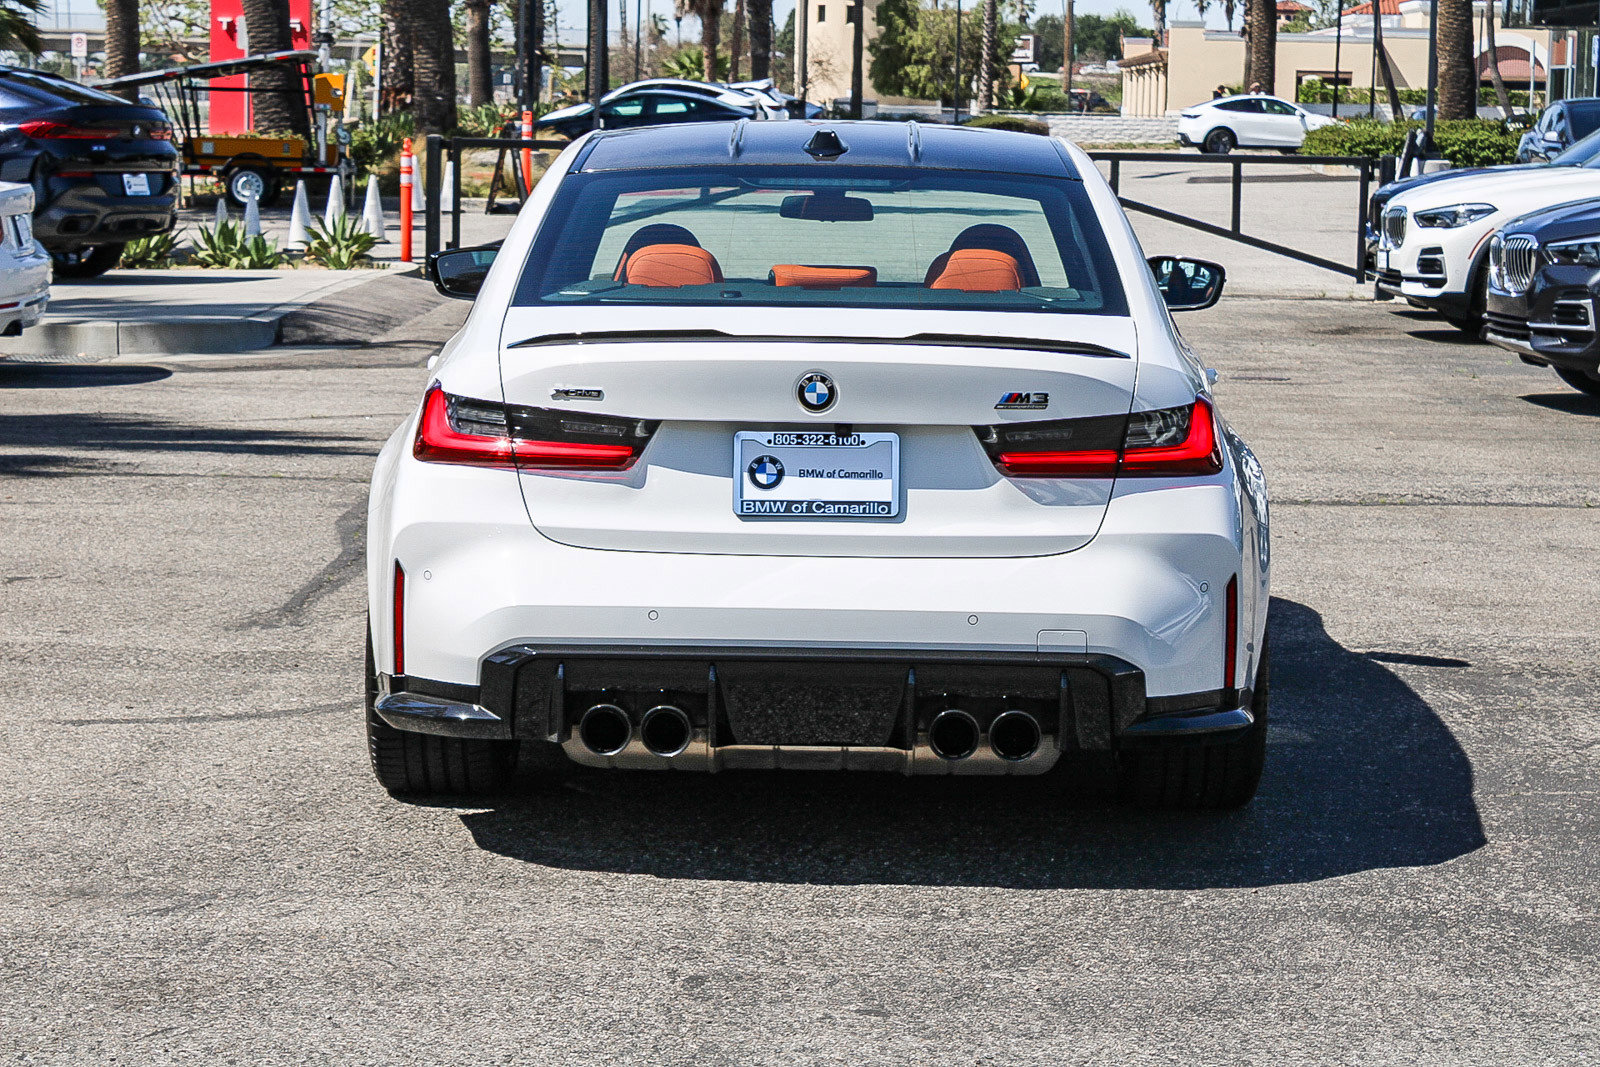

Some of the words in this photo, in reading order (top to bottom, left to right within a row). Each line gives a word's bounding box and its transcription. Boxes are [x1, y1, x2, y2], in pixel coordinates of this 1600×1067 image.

[801, 375, 833, 388] BMW
[775, 434, 859, 446] 805-322-6100
[751, 456, 783, 470] BMW
[798, 469, 825, 478] BMW
[826, 469, 837, 479] of
[837, 469, 884, 479] Camarillo
[742, 501, 787, 513] BMW
[791, 501, 808, 514] of
[811, 501, 889, 515] Camarillo
